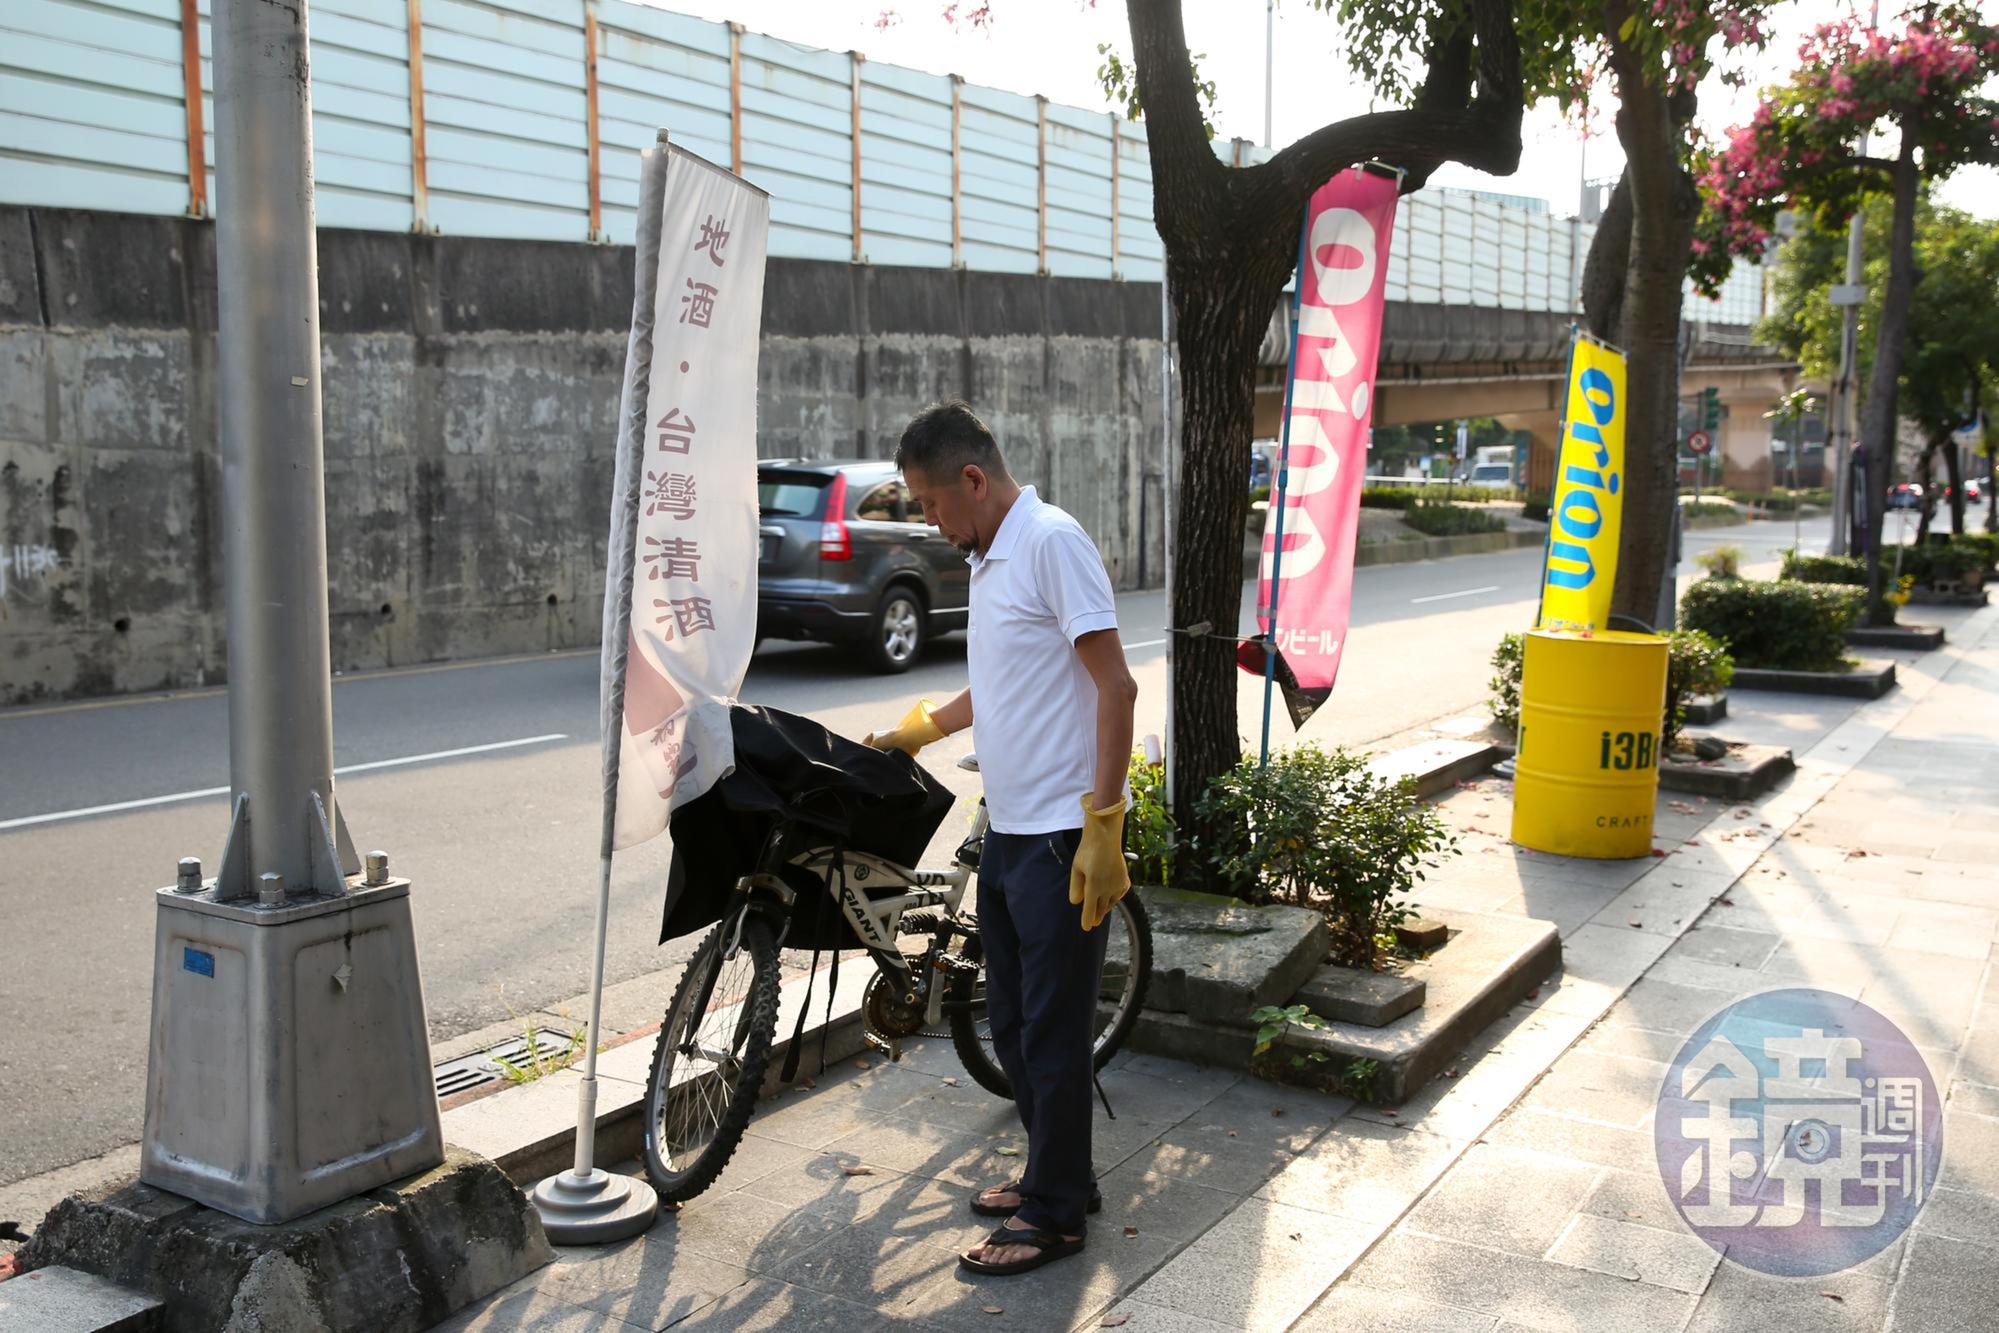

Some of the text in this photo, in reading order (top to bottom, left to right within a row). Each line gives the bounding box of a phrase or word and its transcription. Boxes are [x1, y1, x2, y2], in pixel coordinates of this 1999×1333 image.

[1263, 207, 1377, 580] orion
[1547, 367, 1619, 590] orion
[844, 887, 882, 943] GIANT
